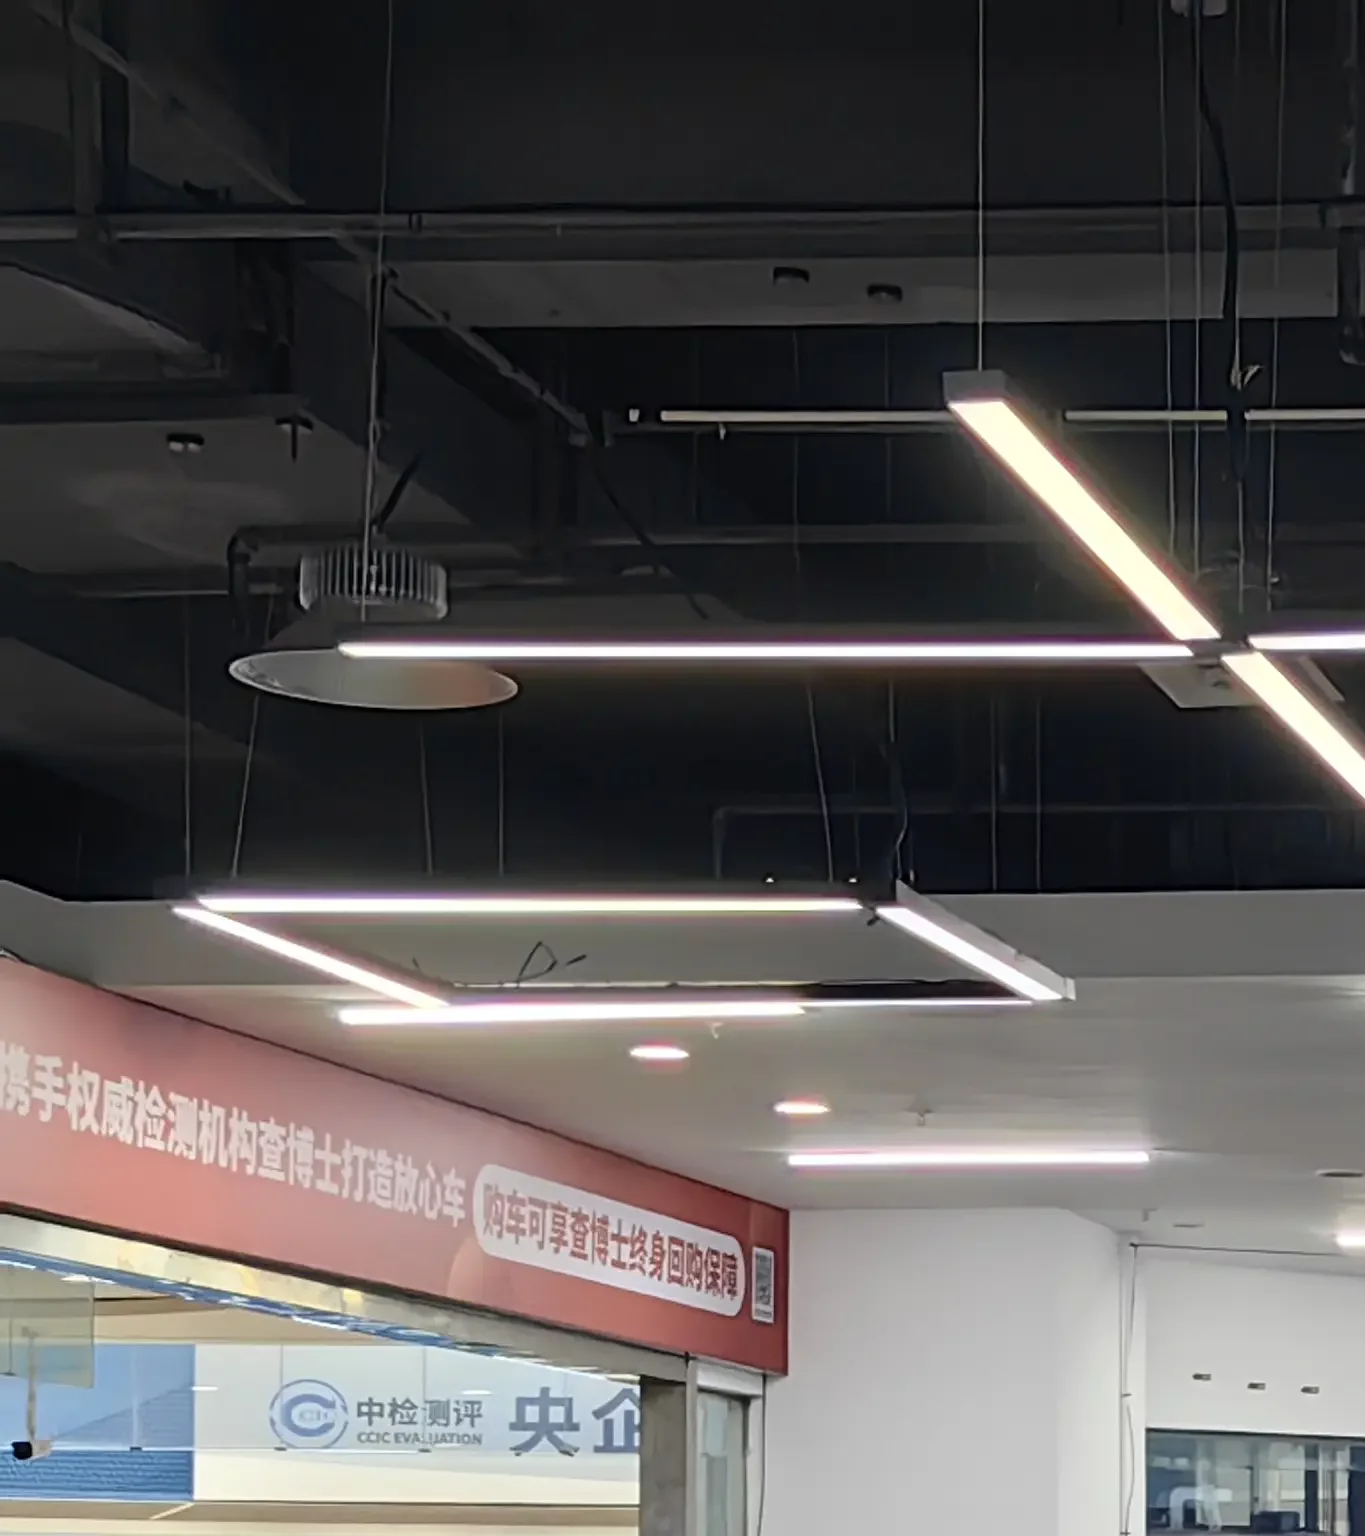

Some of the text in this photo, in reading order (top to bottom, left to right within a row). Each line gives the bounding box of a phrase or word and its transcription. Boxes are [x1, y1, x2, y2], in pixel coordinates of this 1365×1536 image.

[0, 1041, 466, 1227] 携手权威检测机构查博士打造放心车
[482, 1183, 739, 1300] 购车可享查博士终身回购保障
[357, 1397, 483, 1428] 中检测评
[357, 1432, 390, 1444] CCIC
